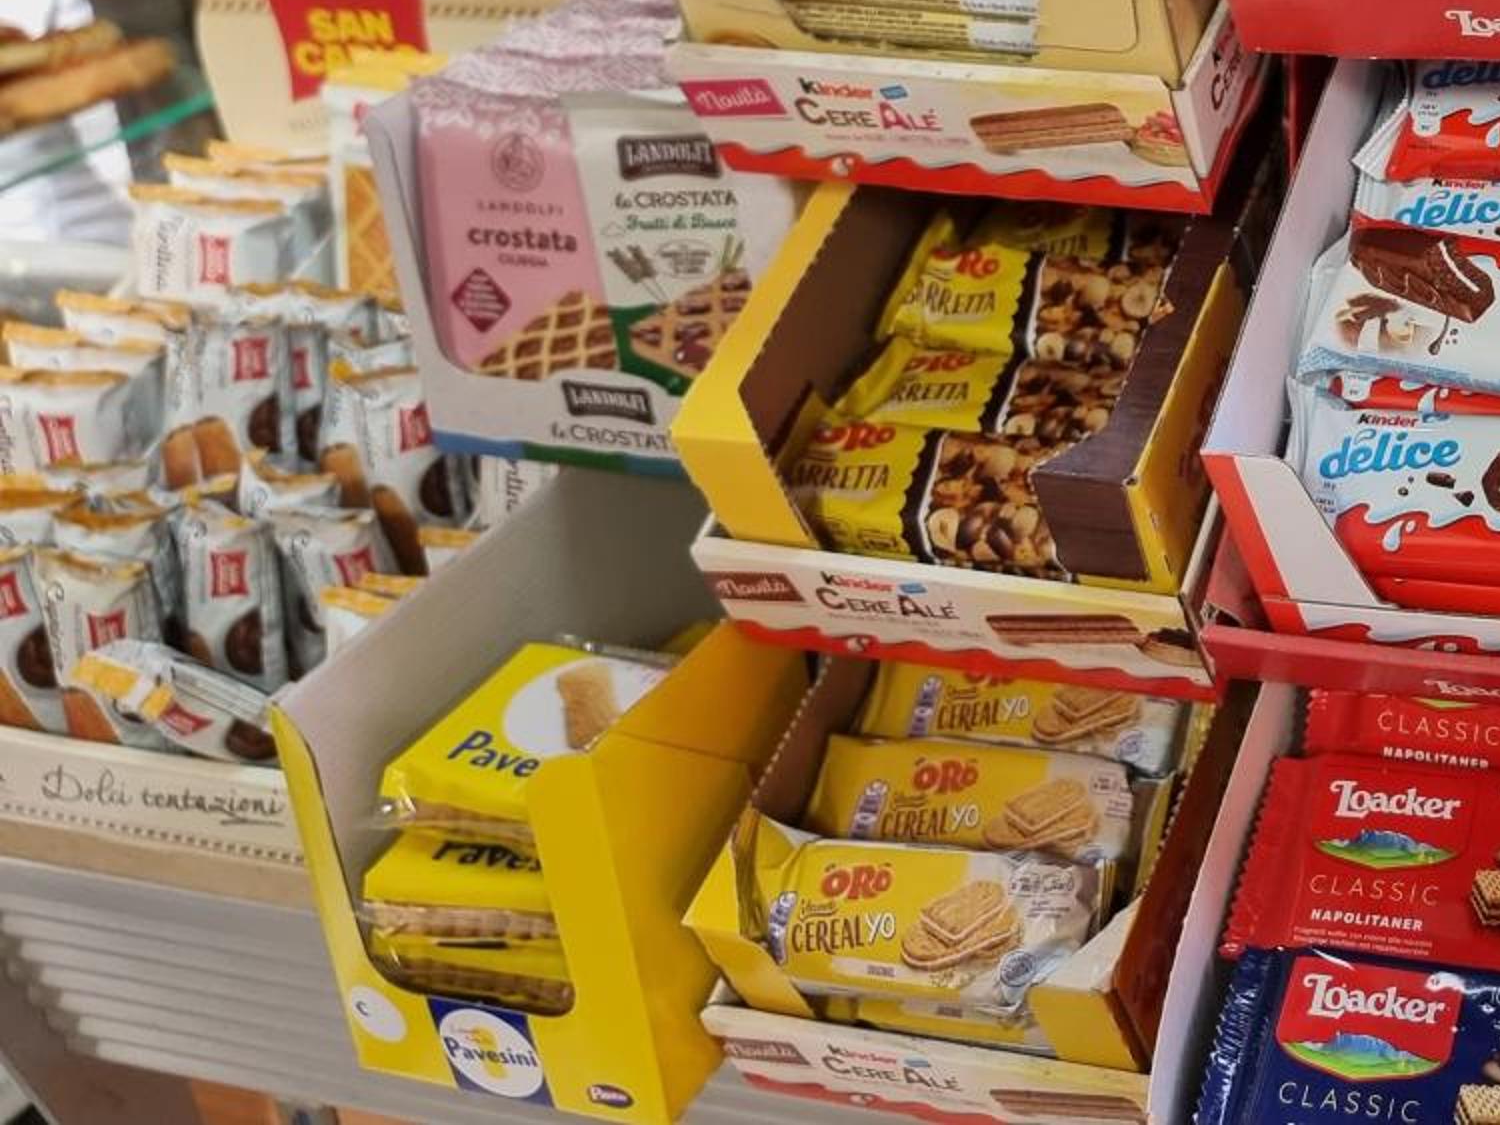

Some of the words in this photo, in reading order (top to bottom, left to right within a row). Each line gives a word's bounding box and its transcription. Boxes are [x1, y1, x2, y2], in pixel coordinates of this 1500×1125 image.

[306, 7, 393, 44] SAN
[697, 88, 771, 111] Novità
[625, 139, 711, 164] LANDOLFI
[635, 190, 738, 209] CROSTATA
[467, 226, 578, 252] crostata
[1357, 412, 1421, 427] Kinder
[447, 729, 541, 779] Pave
[1382, 746, 1490, 770] NAPOLITANER
[41, 764, 132, 807] Dolci
[141, 788, 285, 820] tentazioni
[913, 759, 979, 794] ORO
[1329, 780, 1461, 820] Loacker
[821, 863, 892, 900] ORO
[1308, 874, 1441, 906] CLASSIC
[1310, 908, 1424, 932] NAPOLITANER
[1303, 972, 1447, 1025] Loacker
[443, 1035, 539, 1068] Pavesini
[1277, 1082, 1421, 1123] CLASSIC
